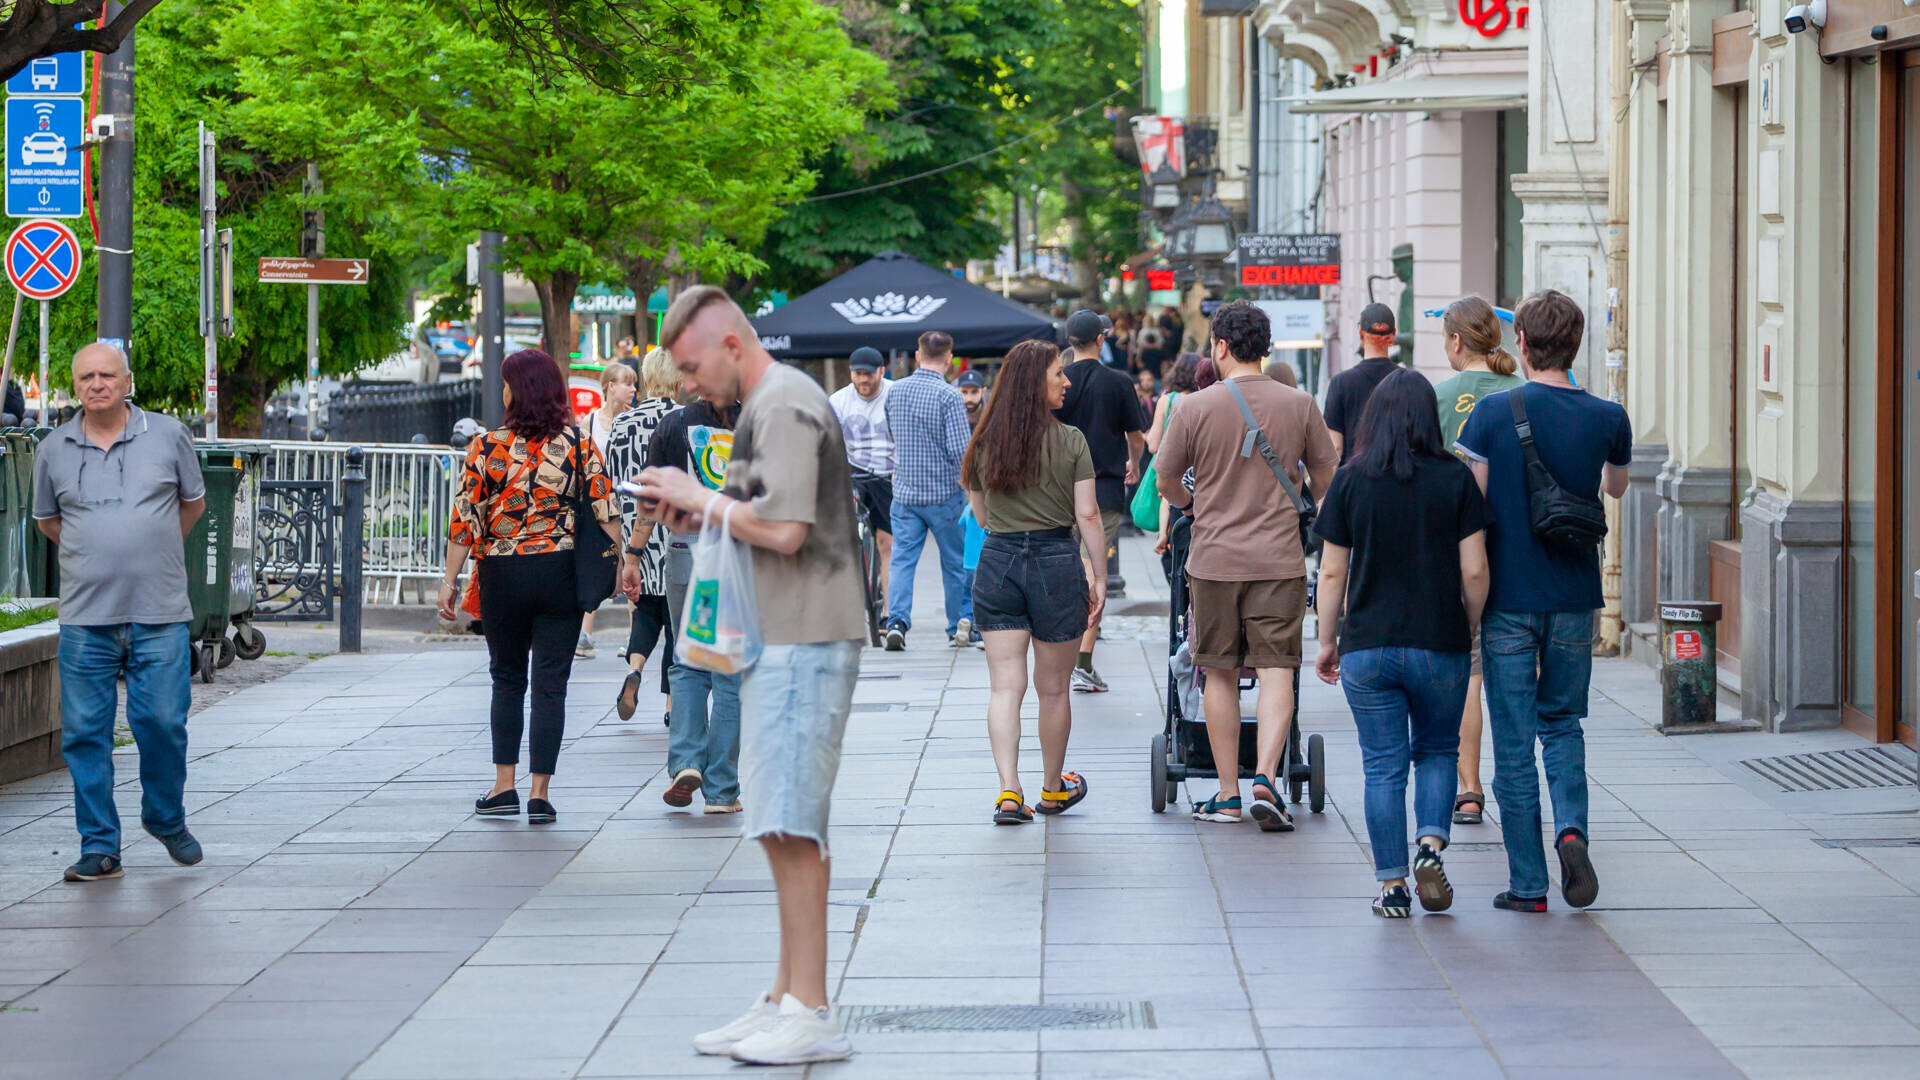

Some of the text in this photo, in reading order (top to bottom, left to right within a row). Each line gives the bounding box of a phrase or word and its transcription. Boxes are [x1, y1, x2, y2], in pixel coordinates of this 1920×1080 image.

[1248, 247, 1328, 257] EXCHANGE
[1242, 265, 1340, 285] EXCHANGE
[574, 295, 636, 311] BORJOM
